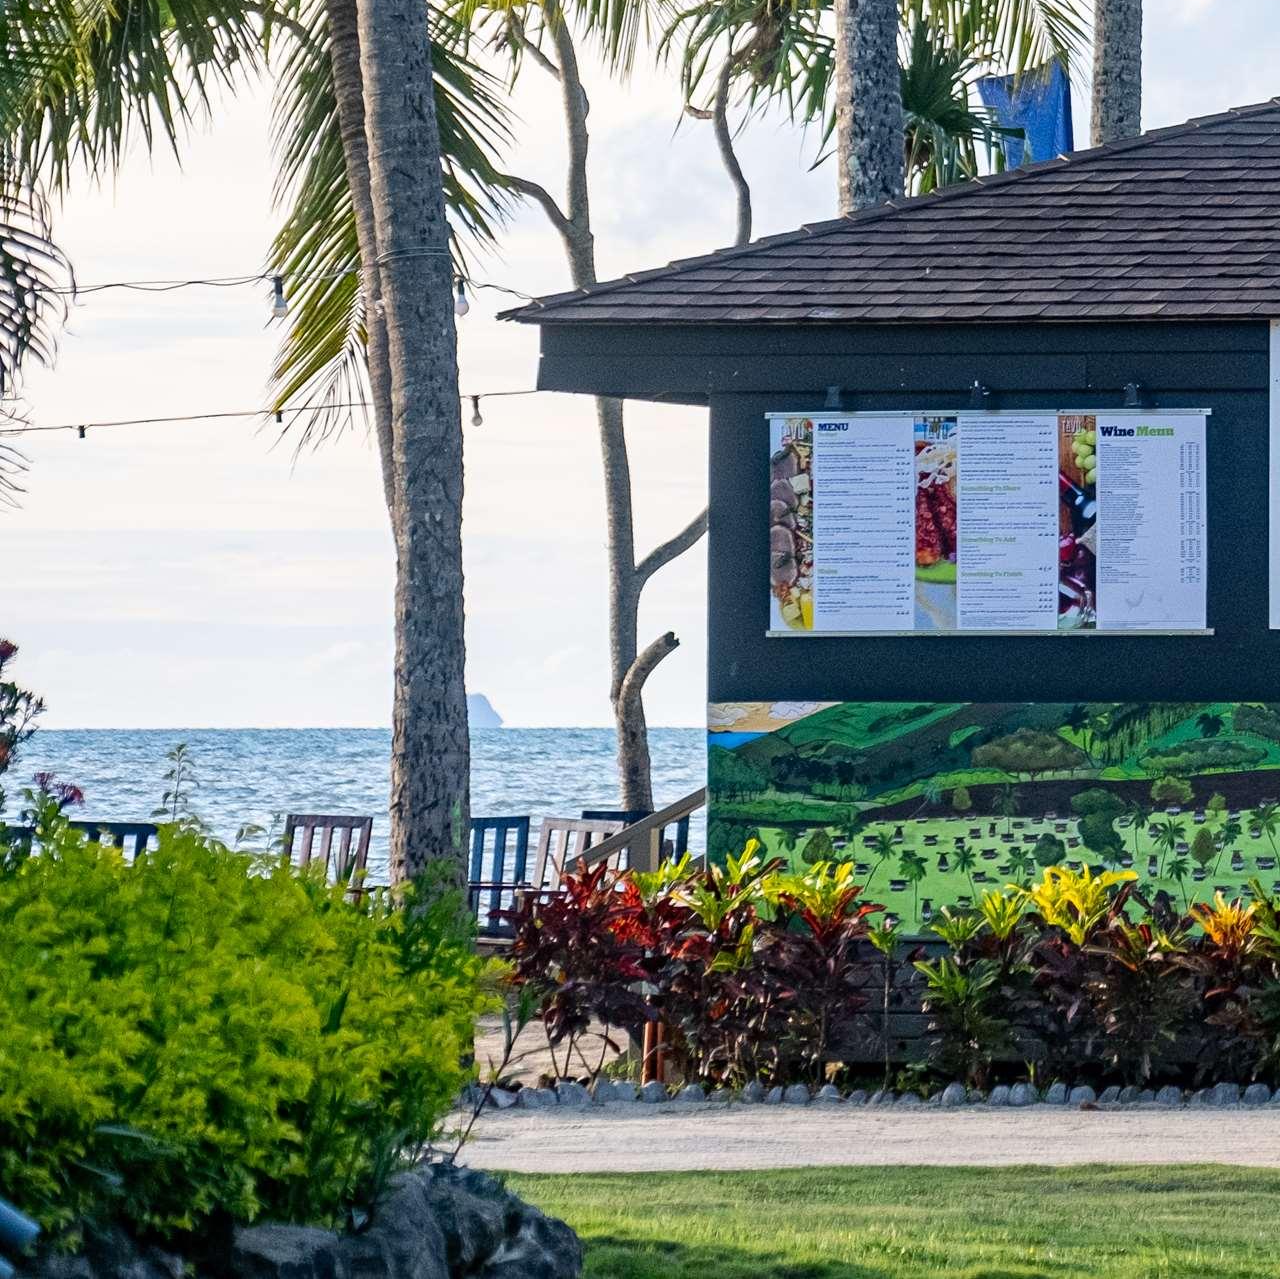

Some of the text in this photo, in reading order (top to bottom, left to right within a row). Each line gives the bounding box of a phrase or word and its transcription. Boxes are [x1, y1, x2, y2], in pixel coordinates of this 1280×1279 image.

[818, 423, 849, 432] MENU
[1100, 426, 1175, 437] Wine Menu
